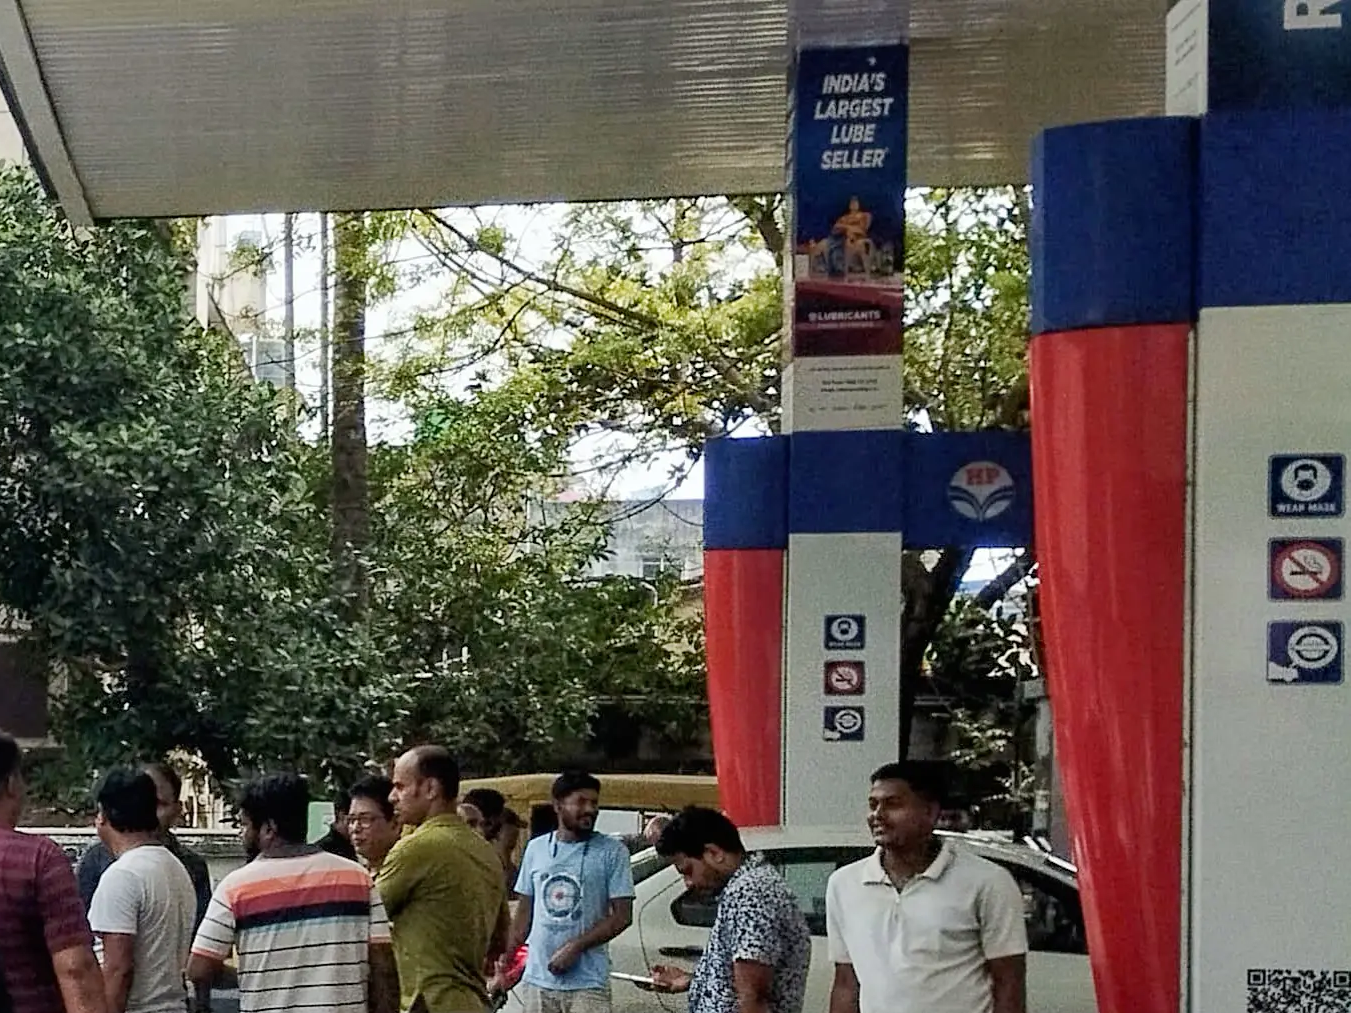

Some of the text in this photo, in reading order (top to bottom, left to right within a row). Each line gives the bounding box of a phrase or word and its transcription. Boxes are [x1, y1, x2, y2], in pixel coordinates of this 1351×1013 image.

[822, 72, 887, 94] INDIA'S
[814, 97, 894, 120] LARGEST
[831, 123, 876, 144] LUBE
[821, 148, 885, 170] SELLER
[965, 467, 1000, 486] HP
